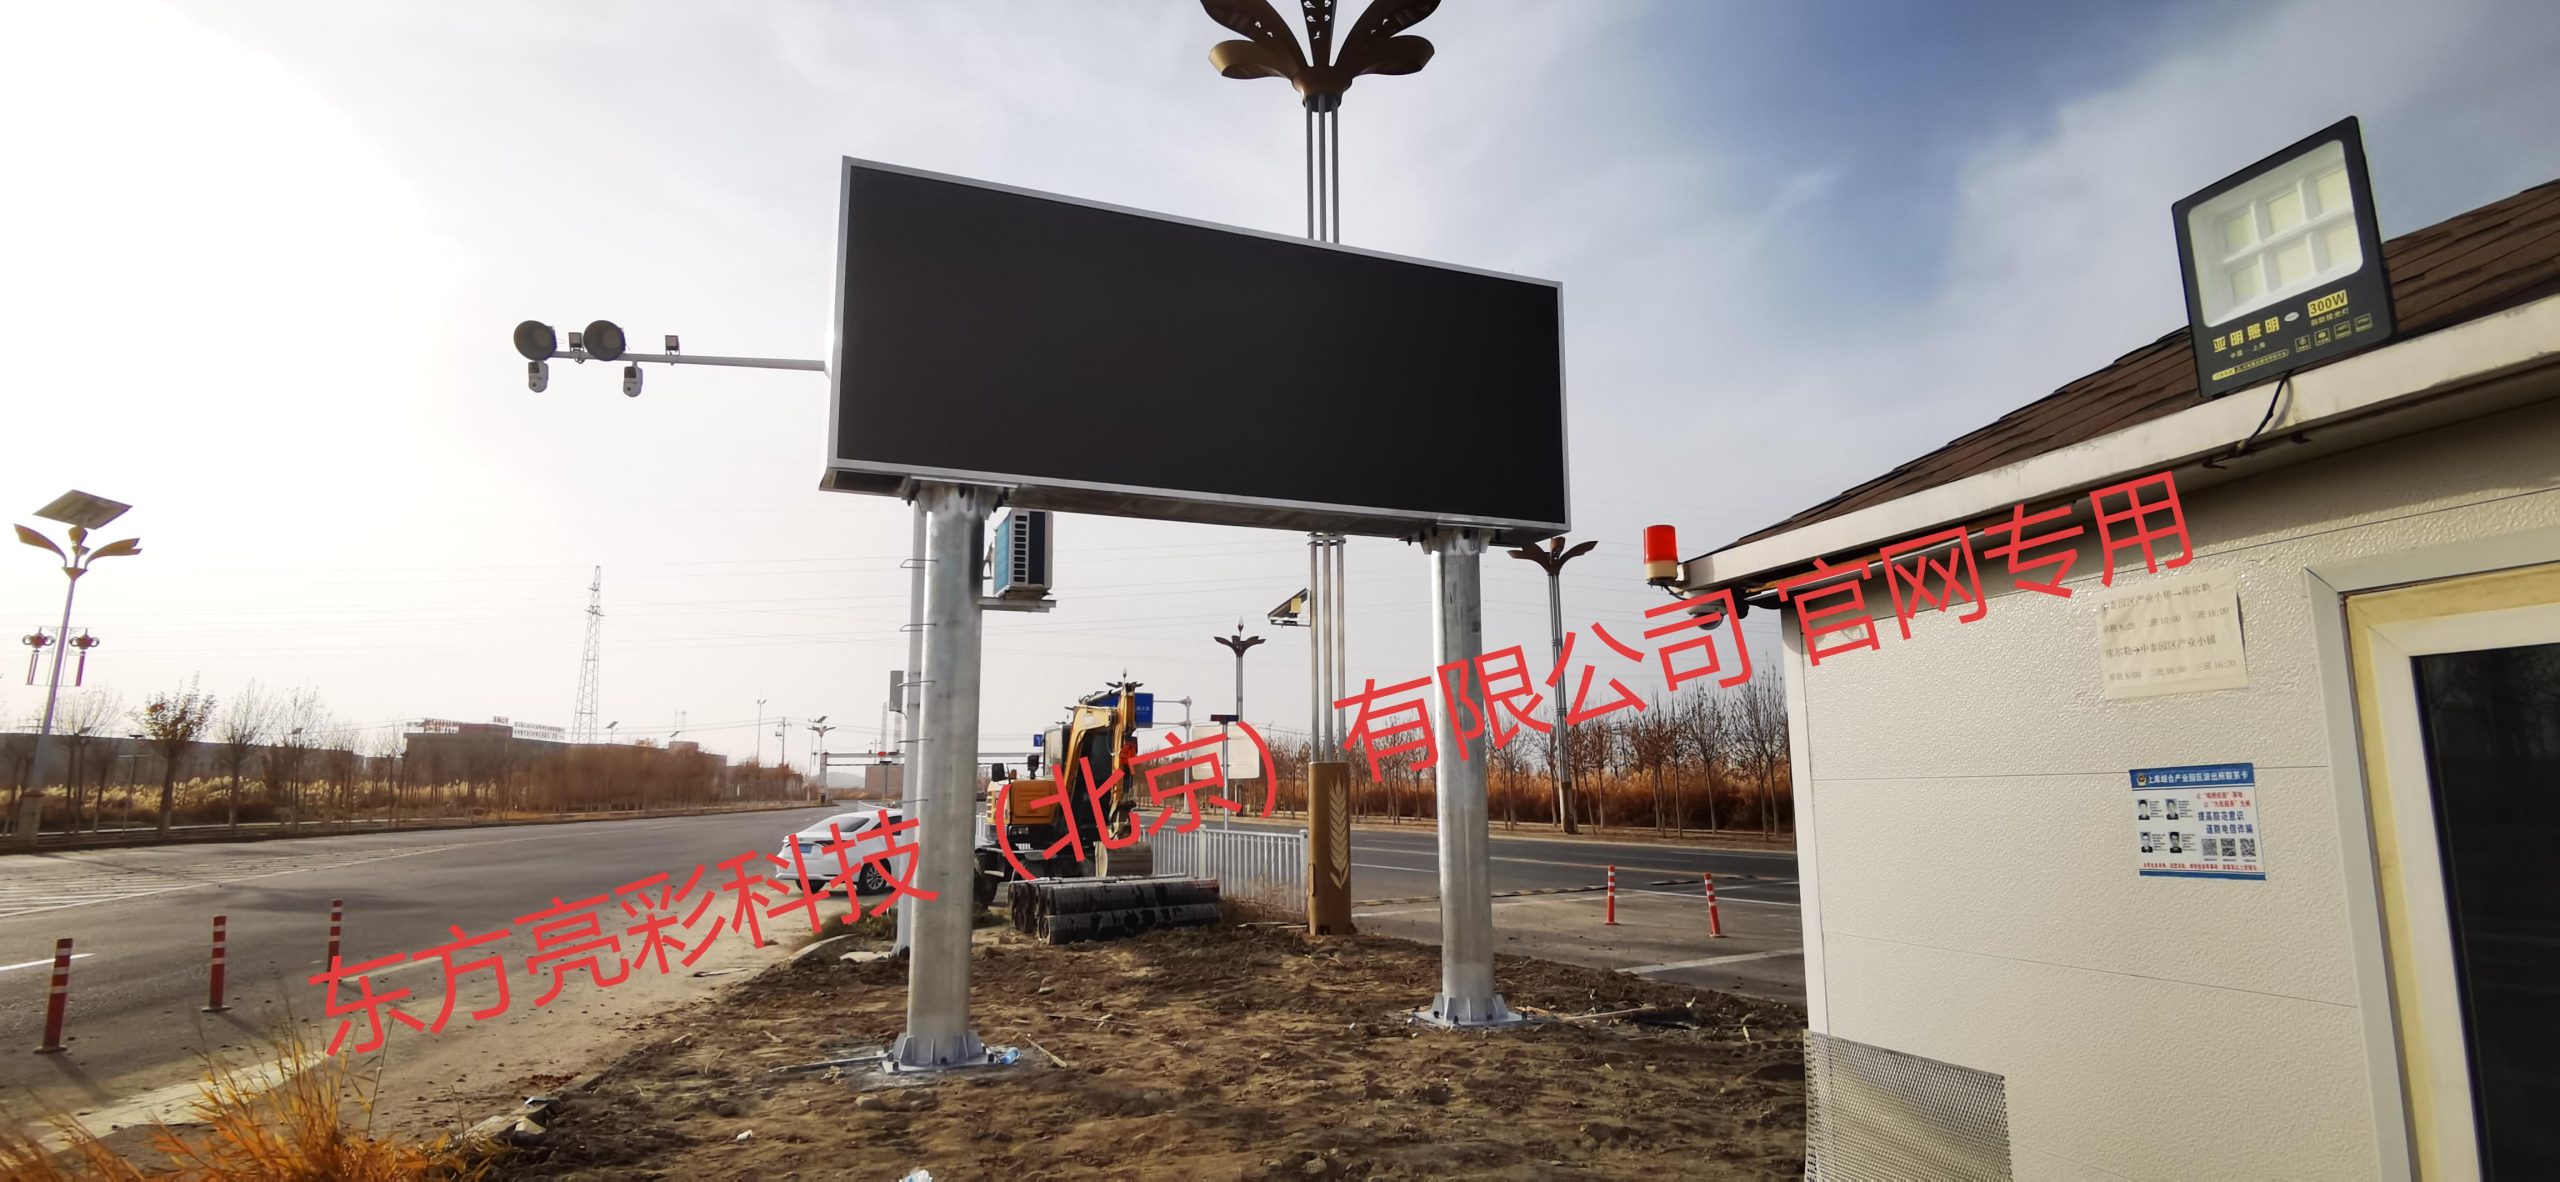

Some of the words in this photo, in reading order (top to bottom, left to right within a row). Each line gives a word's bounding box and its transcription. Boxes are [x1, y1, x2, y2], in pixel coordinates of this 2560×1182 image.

[2309, 292, 2346, 315] 300W
[2212, 316, 2280, 352] 亚明照明
[2197, 811, 2245, 821] 提高防范意识
[2206, 824, 2253, 834] 谨防电信诈骗
